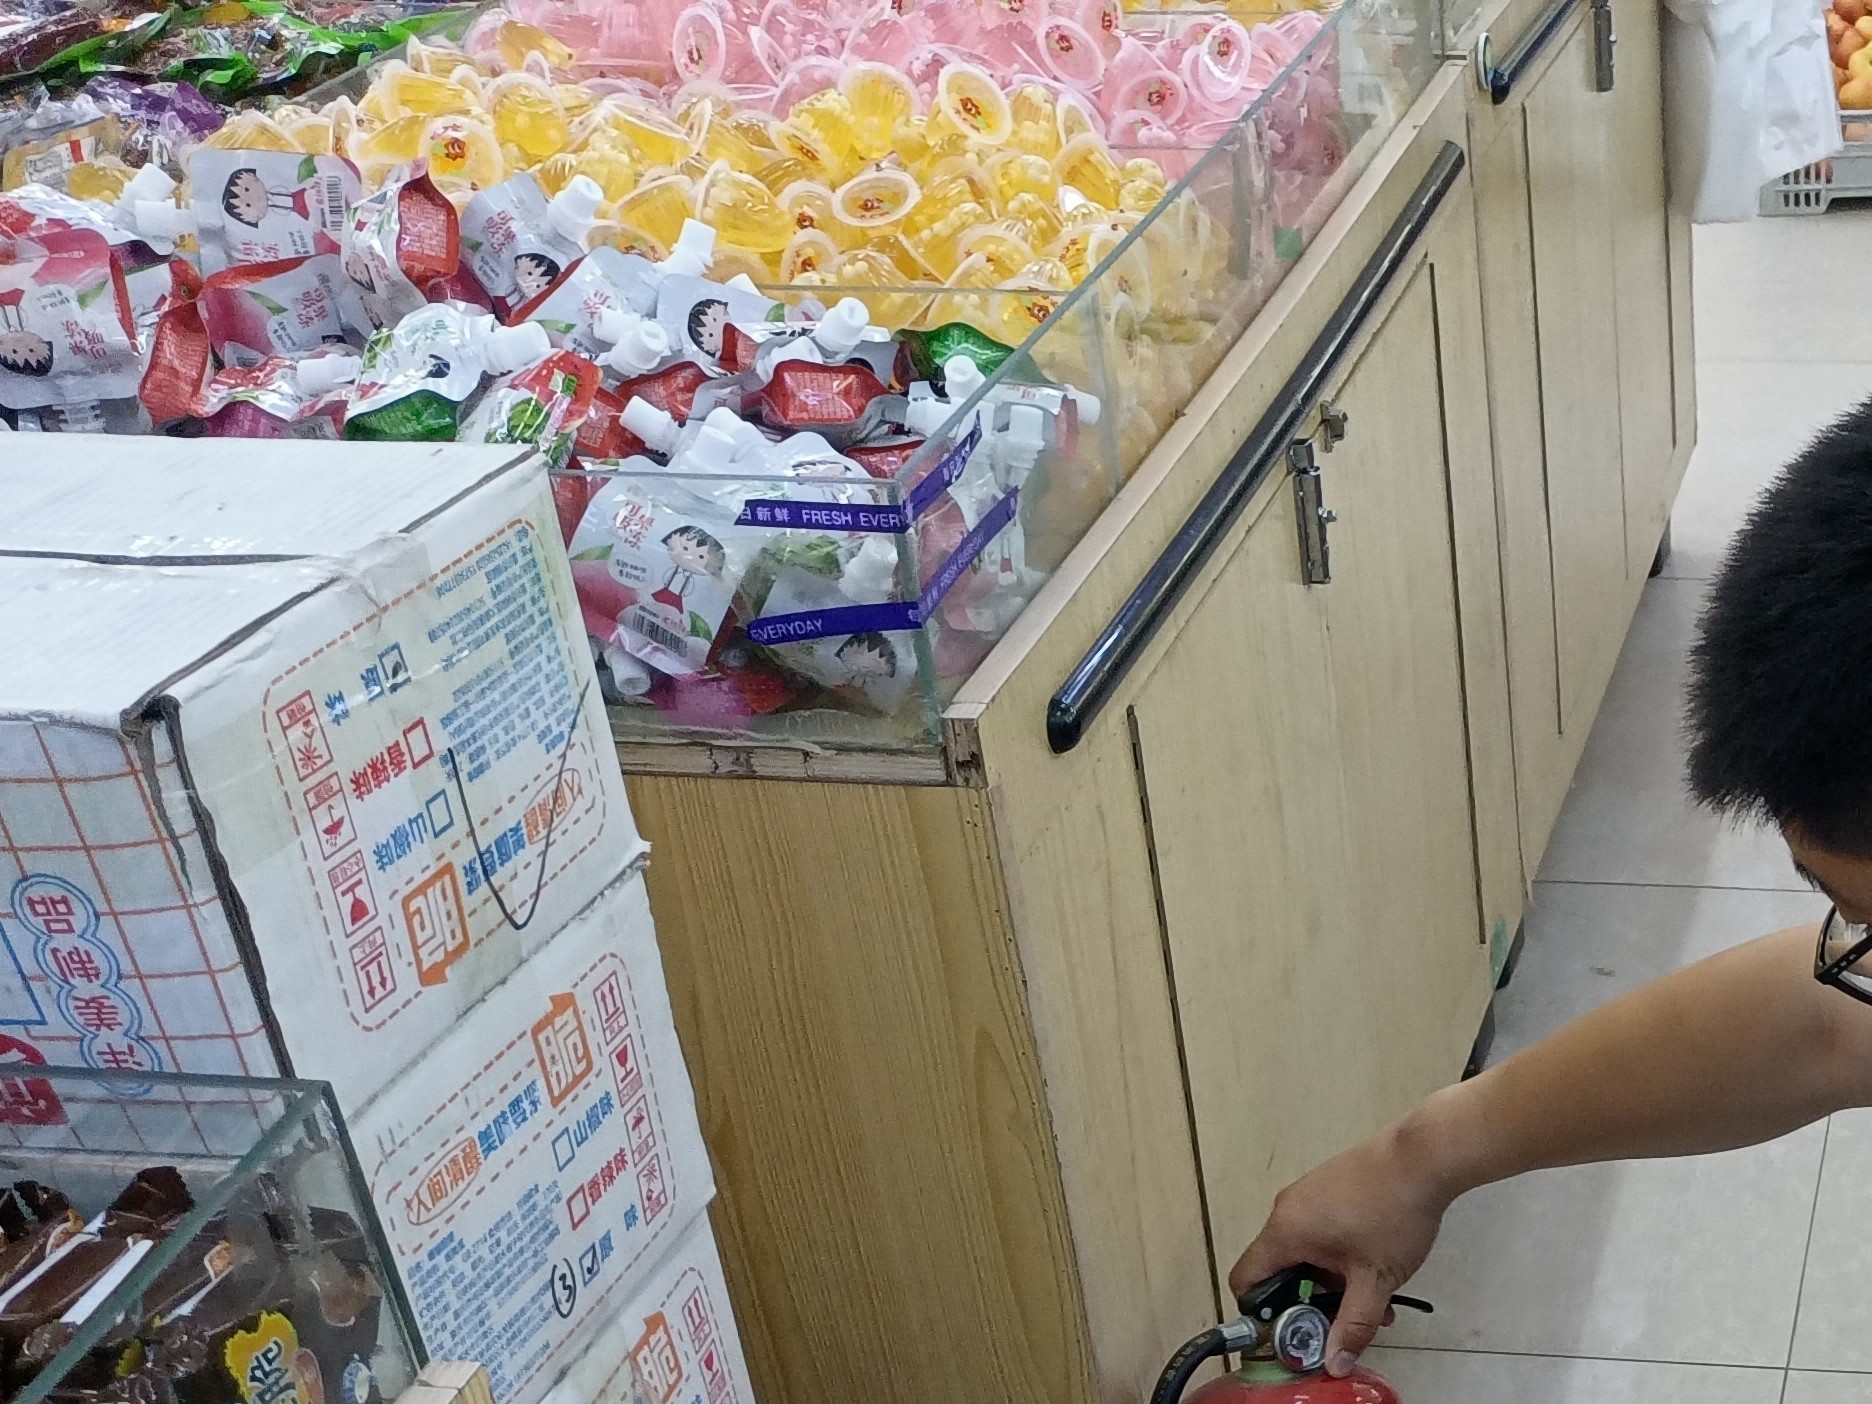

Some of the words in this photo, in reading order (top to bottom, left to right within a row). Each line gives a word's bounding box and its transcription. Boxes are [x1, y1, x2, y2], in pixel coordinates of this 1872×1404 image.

[802, 509, 853, 526] FRESH
[750, 617, 824, 641] EVERYDAY
[349, 737, 409, 802] 香辣味
[374, 810, 432, 873] 山椒味
[409, 876, 465, 968] 脆
[541, 1010, 590, 1094] 脆
[573, 1090, 616, 1148] 山椒味
